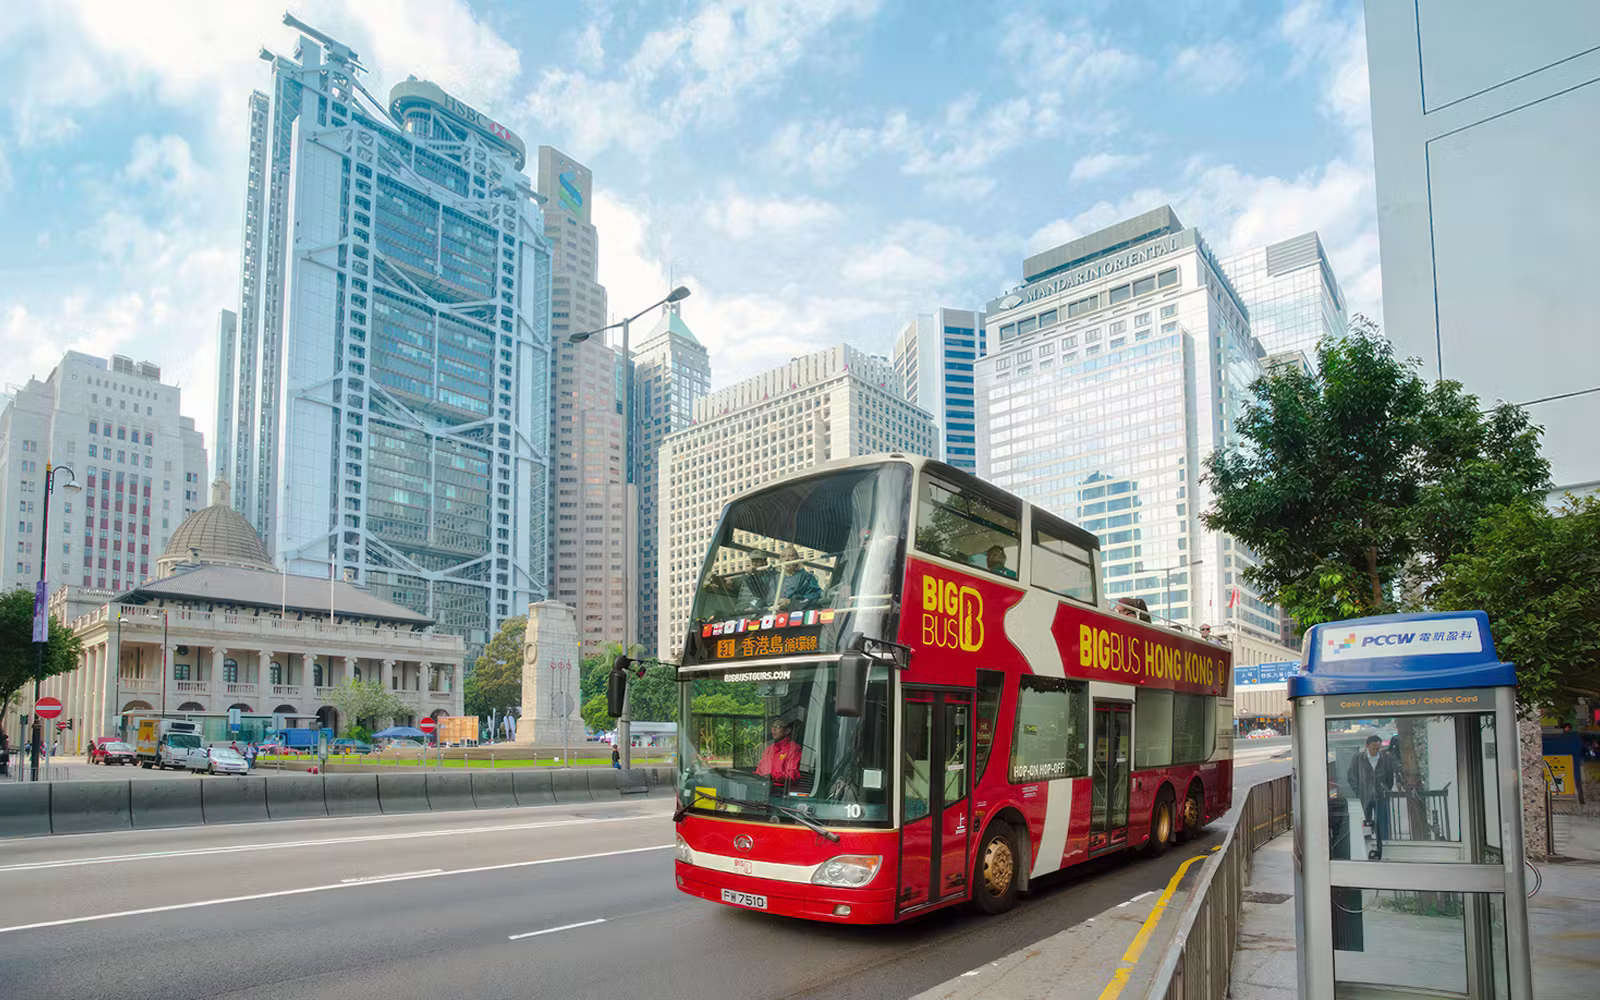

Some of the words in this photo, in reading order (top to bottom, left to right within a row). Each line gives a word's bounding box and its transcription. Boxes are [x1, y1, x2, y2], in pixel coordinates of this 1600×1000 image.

[444, 94, 488, 129] HSBC
[1026, 264, 1101, 303] MANDARIN
[1103, 238, 1179, 276] ORIENTAL
[922, 574, 958, 616] BIG
[922, 613, 958, 650] BUS
[1361, 632, 1416, 648] PCCW
[1144, 640, 1182, 681] HONG
[1184, 651, 1214, 687] KONG
[723, 671, 791, 683] BIGBUSTOURS.COM
[1340, 700, 1361, 709] Coin
[1367, 697, 1417, 707] Phonecard
[1013, 764, 1039, 778] HOP-ON
[1039, 762, 1065, 775] HOP-OFF
[844, 803, 861, 819] 10
[738, 893, 765, 908] 7510
